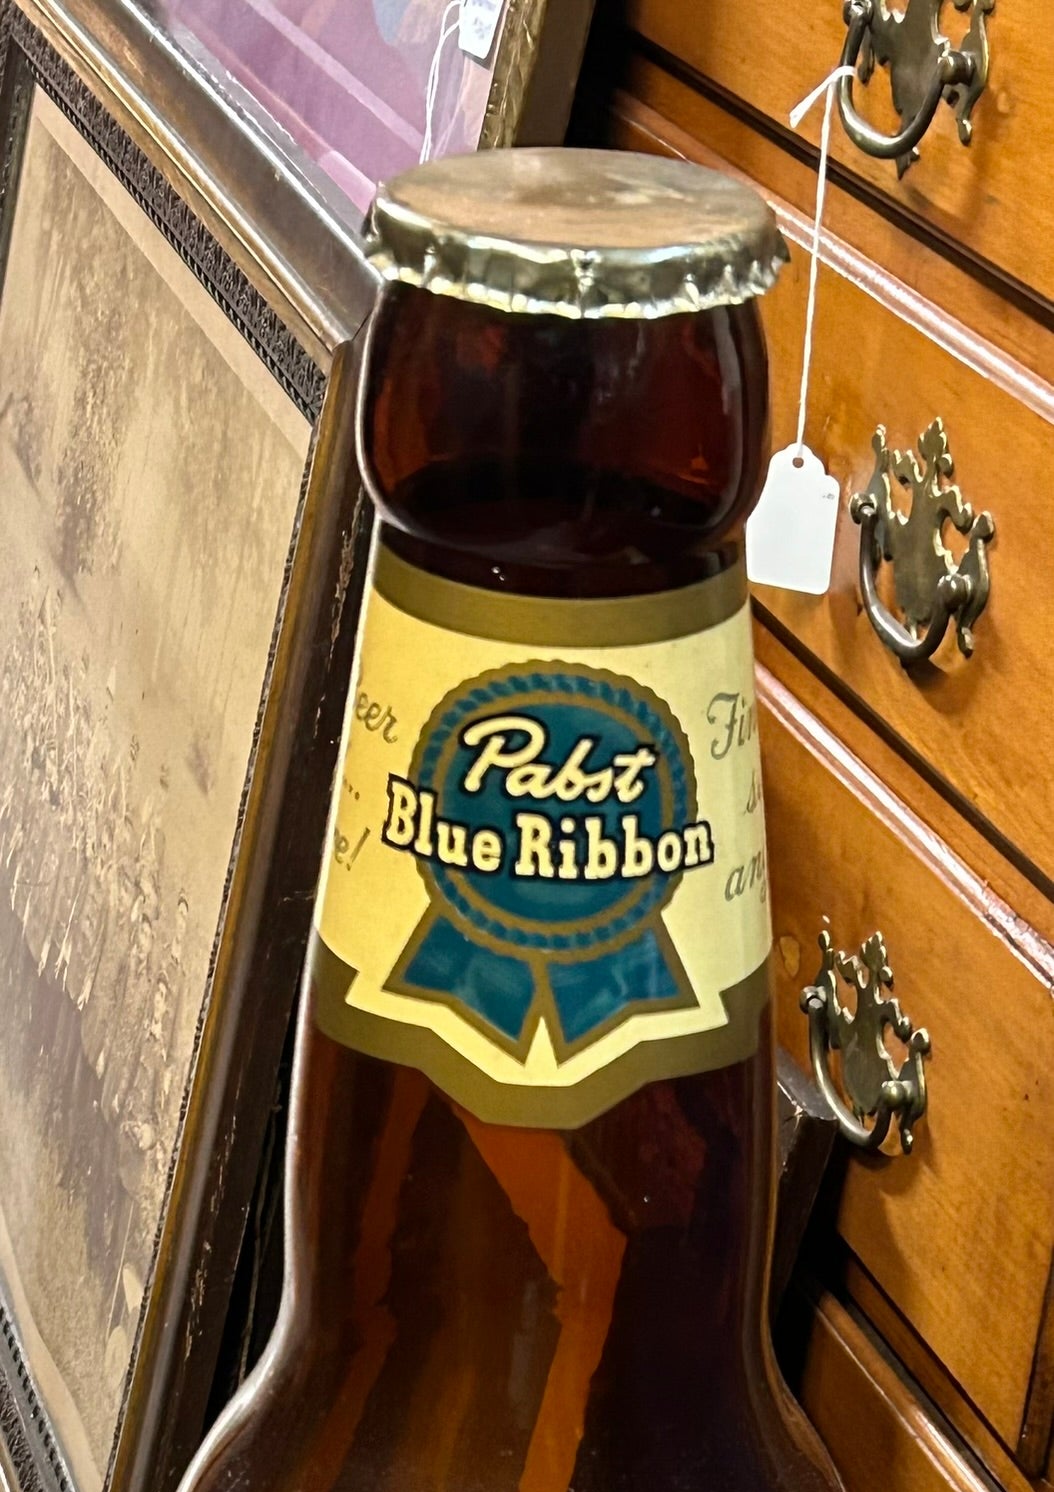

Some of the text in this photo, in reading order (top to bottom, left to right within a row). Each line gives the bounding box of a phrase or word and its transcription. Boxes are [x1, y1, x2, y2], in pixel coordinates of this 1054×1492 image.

[461, 713, 657, 805] Pabst
[385, 776, 713, 881] Blue Ribbon
